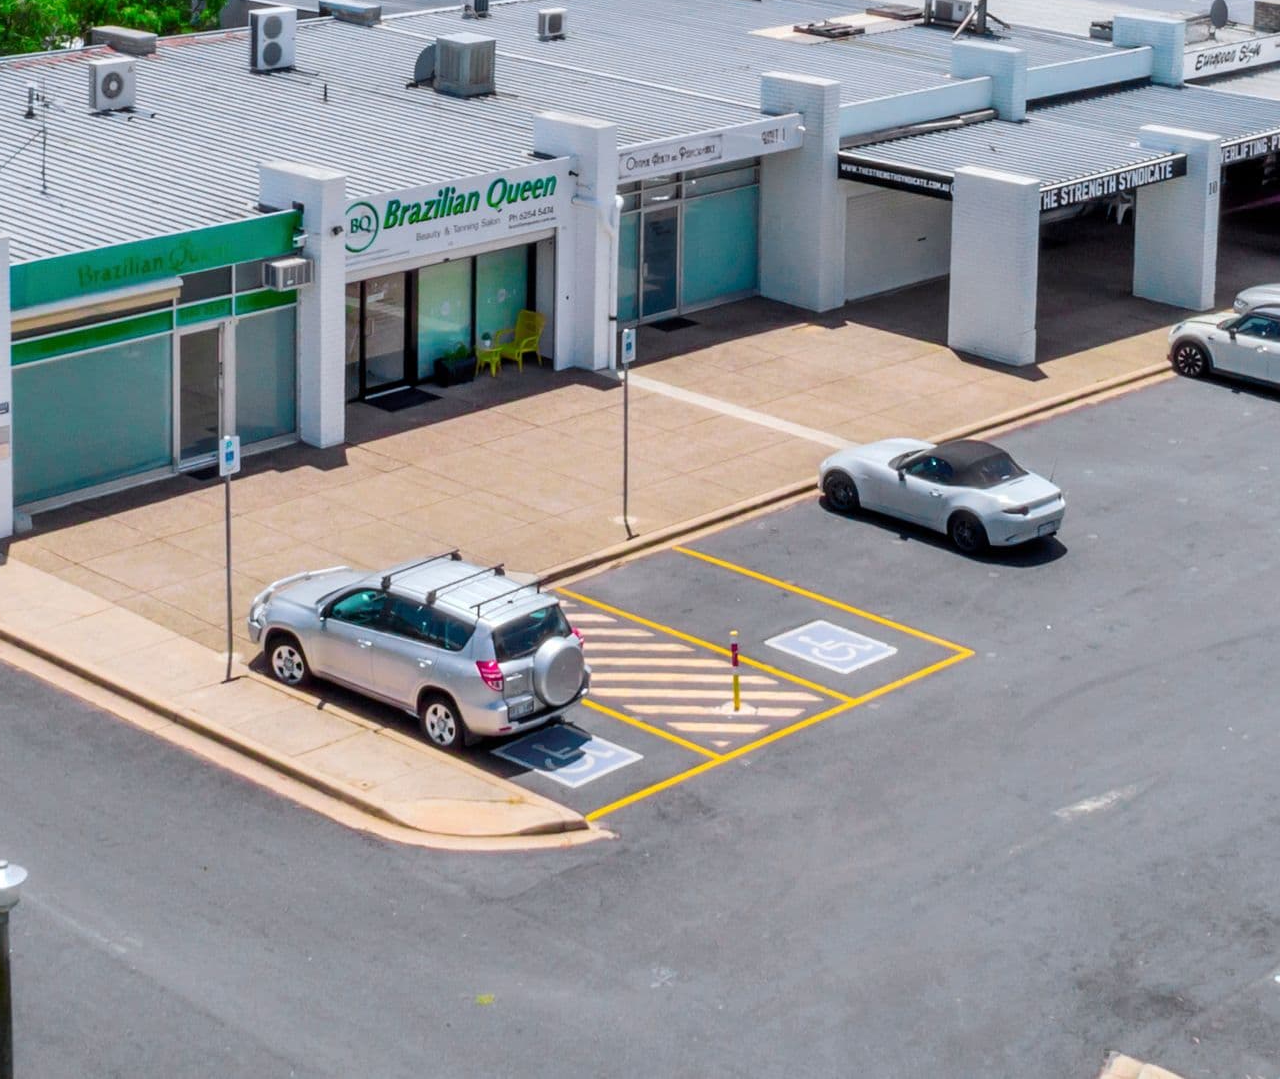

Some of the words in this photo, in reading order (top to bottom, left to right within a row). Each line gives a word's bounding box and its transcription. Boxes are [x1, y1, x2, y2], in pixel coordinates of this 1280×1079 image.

[1060, 174, 1117, 206] STRENGTH
[1119, 160, 1174, 191] SYNDICATE
[383, 185, 481, 231] Brazilian
[486, 174, 558, 213] Queen
[350, 215, 373, 234] BQ
[416, 229, 442, 242] Beauty
[453, 221, 480, 233] Tanning
[78, 253, 165, 288] Brazilian
